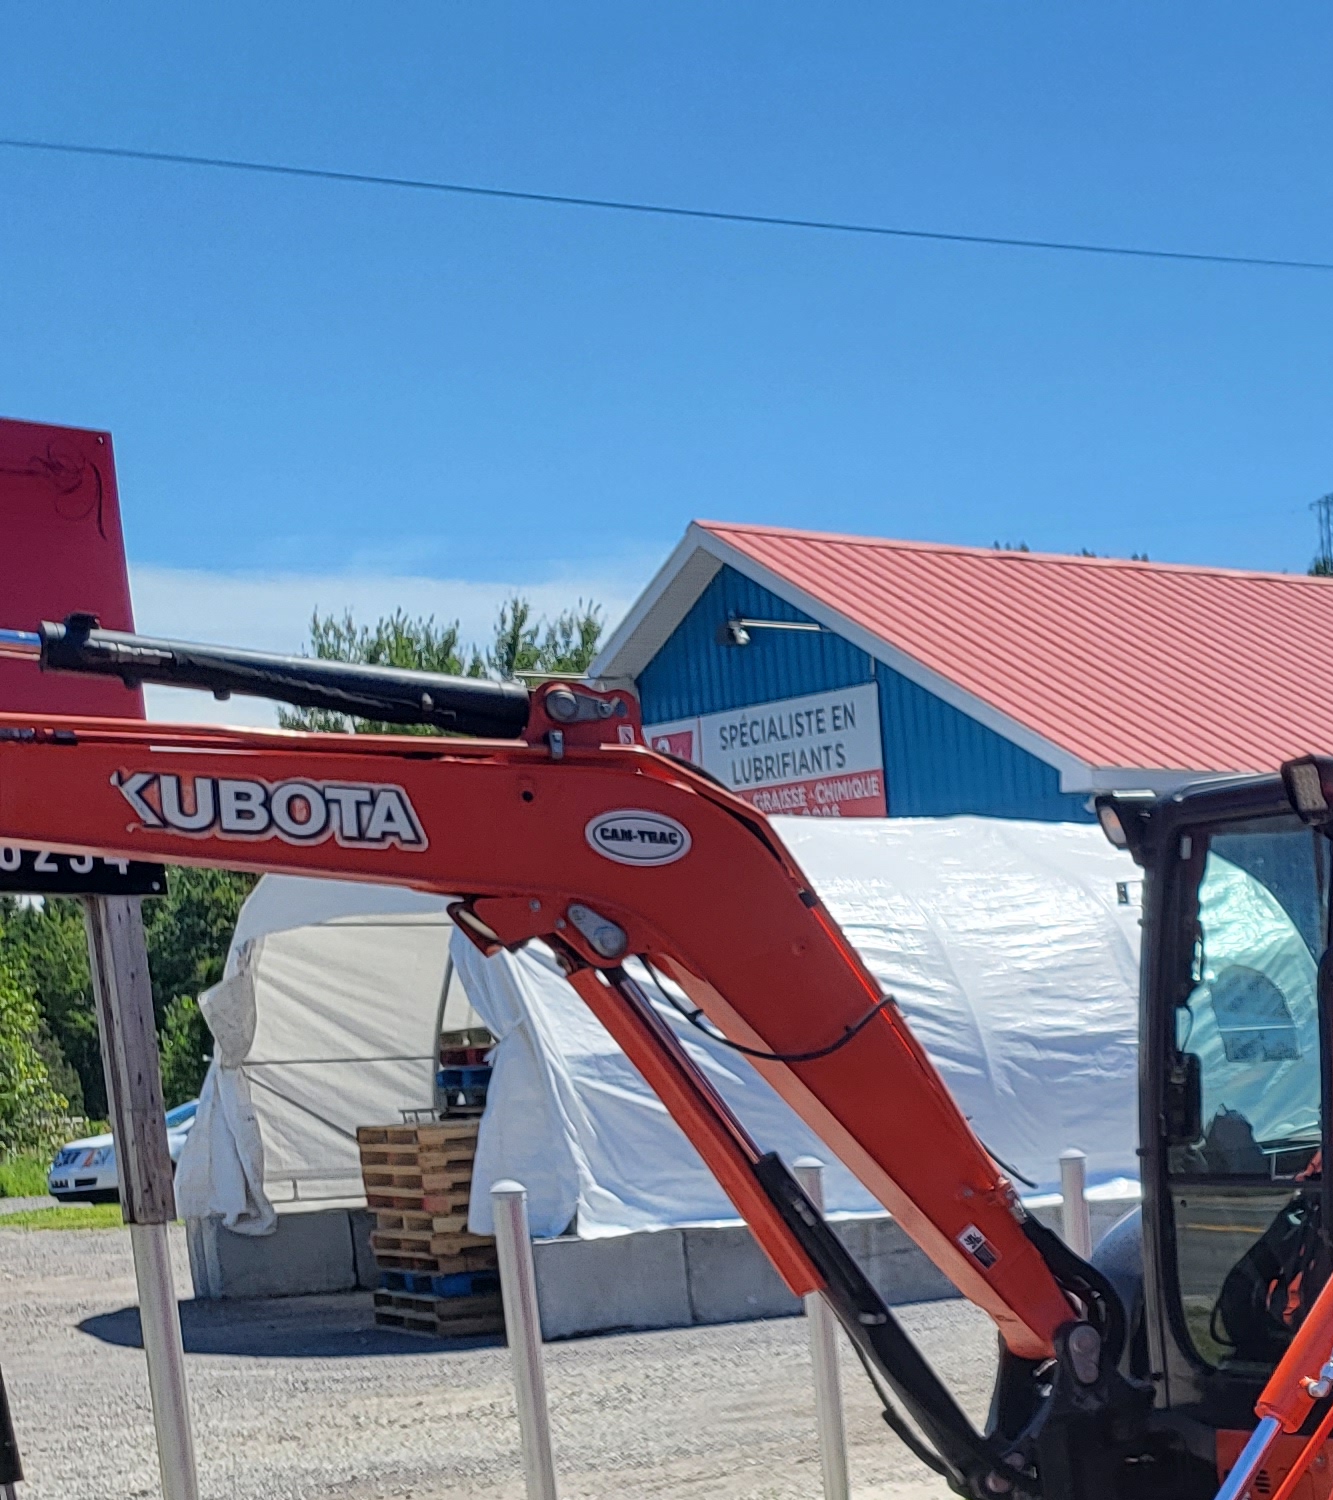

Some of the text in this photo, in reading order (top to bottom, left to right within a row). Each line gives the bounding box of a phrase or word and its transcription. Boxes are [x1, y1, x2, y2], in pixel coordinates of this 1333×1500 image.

[719, 703, 857, 751] SPÉCIALISTE EN
[732, 743, 846, 786] LUBRIFIANTS
[109, 770, 422, 845] KUBOTA
[752, 786, 807, 812] GRAISSE
[814, 775, 880, 804] CHIMIQUE
[600, 827, 678, 846] CAN-TRAC
